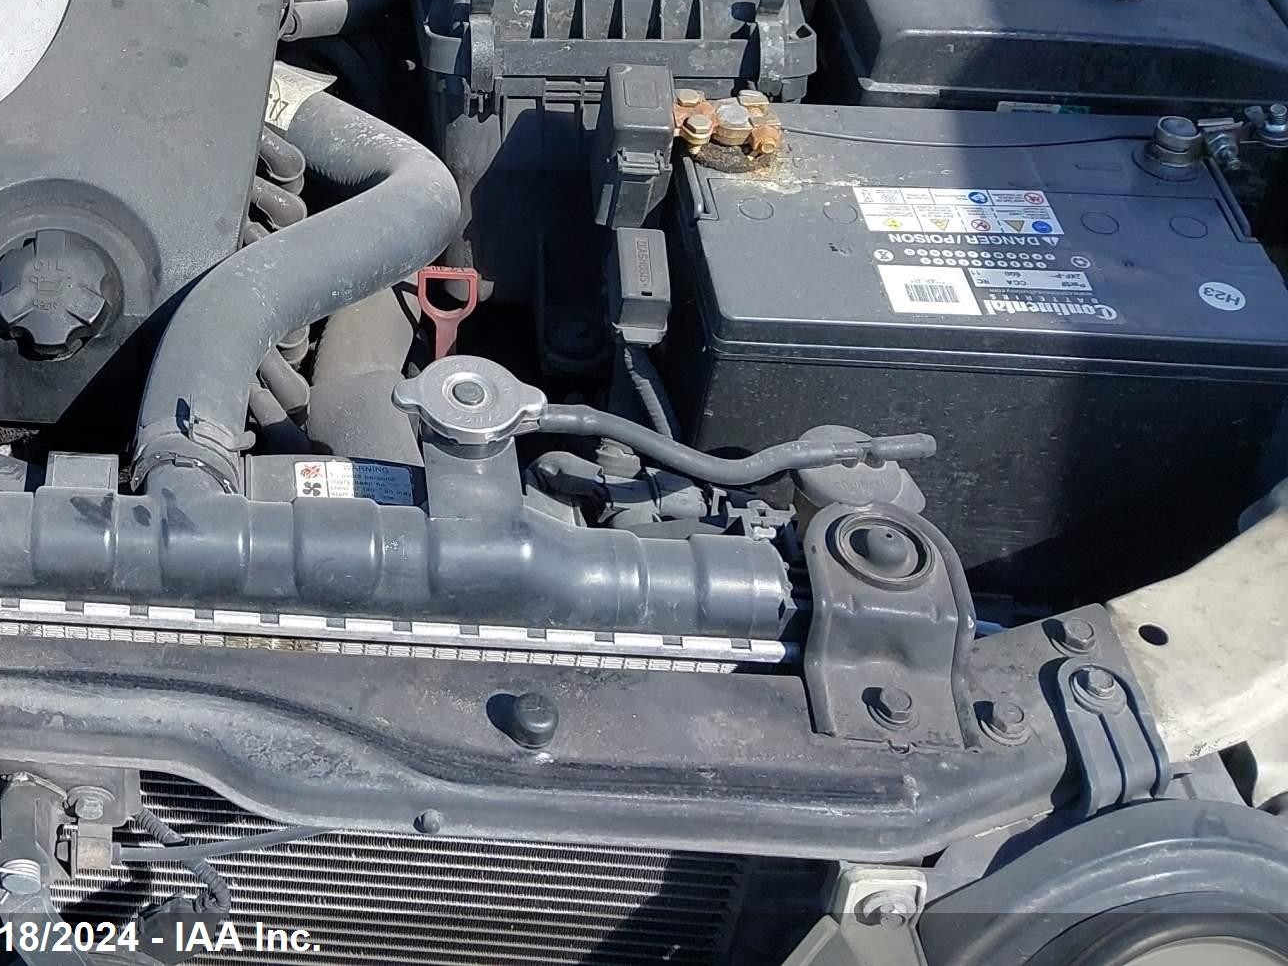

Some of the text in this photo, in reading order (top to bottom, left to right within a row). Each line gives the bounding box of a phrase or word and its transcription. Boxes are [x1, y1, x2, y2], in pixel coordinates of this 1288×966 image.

[888, 233, 956, 245] POISON
[961, 234, 1040, 246] DANGER
[33, 258, 65, 273] OIL
[988, 293, 1099, 304] BATTERIES
[1202, 287, 1241, 307] H23
[983, 299, 1118, 321] Continental
[342, 465, 389, 473] WARNING
